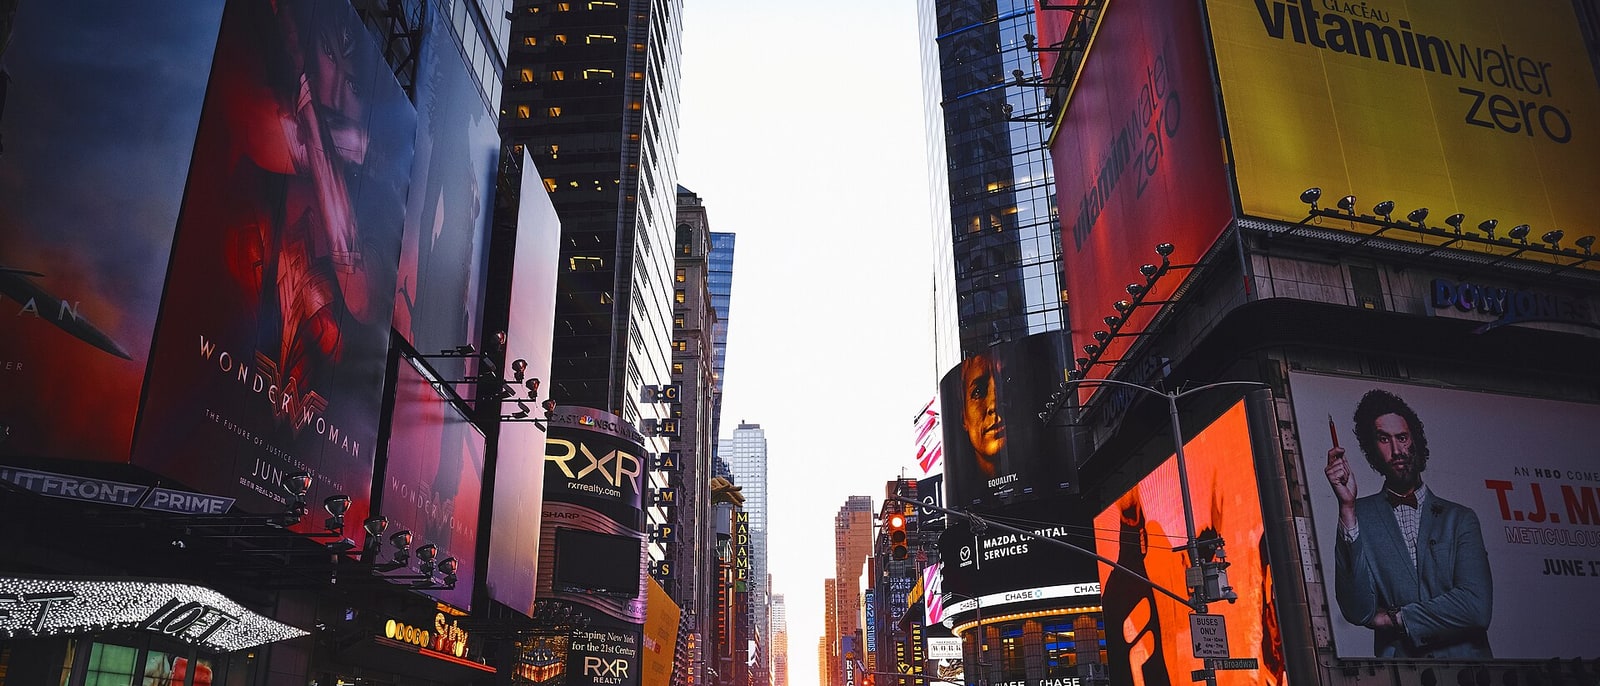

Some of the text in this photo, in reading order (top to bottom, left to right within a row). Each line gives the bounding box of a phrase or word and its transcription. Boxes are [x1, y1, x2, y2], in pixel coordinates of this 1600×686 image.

[1458, 87, 1572, 144] zero
[1134, 88, 1179, 199] zero
[1, 296, 80, 321] AN
[200, 334, 360, 457] WONDER WOMAN
[205, 408, 220, 423] THE
[223, 420, 251, 440] FUTURE
[253, 437, 263, 447] OF
[265, 444, 292, 463] JUSTICE
[252, 458, 288, 488] JUN
[545, 437, 641, 496] RXR
[1514, 467, 1530, 477] AN
[1535, 468, 1561, 479] HBO
[567, 482, 621, 498] rxrrealty.com
[988, 473, 1019, 488] EQUALITY.
[154, 491, 224, 515] PRIME
[392, 476, 475, 539] WONDER WOMAN
[1485, 479, 1600, 526] T.J. M
[542, 512, 580, 520] SHARP
[737, 512, 748, 579] MADAME
[983, 533, 1017, 549] MAZDA
[984, 543, 1029, 561] SERVICES
[1543, 559, 1586, 577] JUNE
[1005, 591, 1033, 601] CHASE
[1074, 584, 1099, 594] CHAS
[145, 596, 241, 644] LOFT
[572, 641, 636, 658] for the 21st Century
[607, 632, 621, 642] New
[622, 633, 635, 644] York
[868, 625, 876, 652] STUDIOS
[912, 623, 923, 661] VICTORY
[584, 656, 629, 678] RXR
[687, 633, 695, 686] AMSTER
[1223, 661, 1256, 669] Broadway
[593, 676, 622, 685] REALTY
